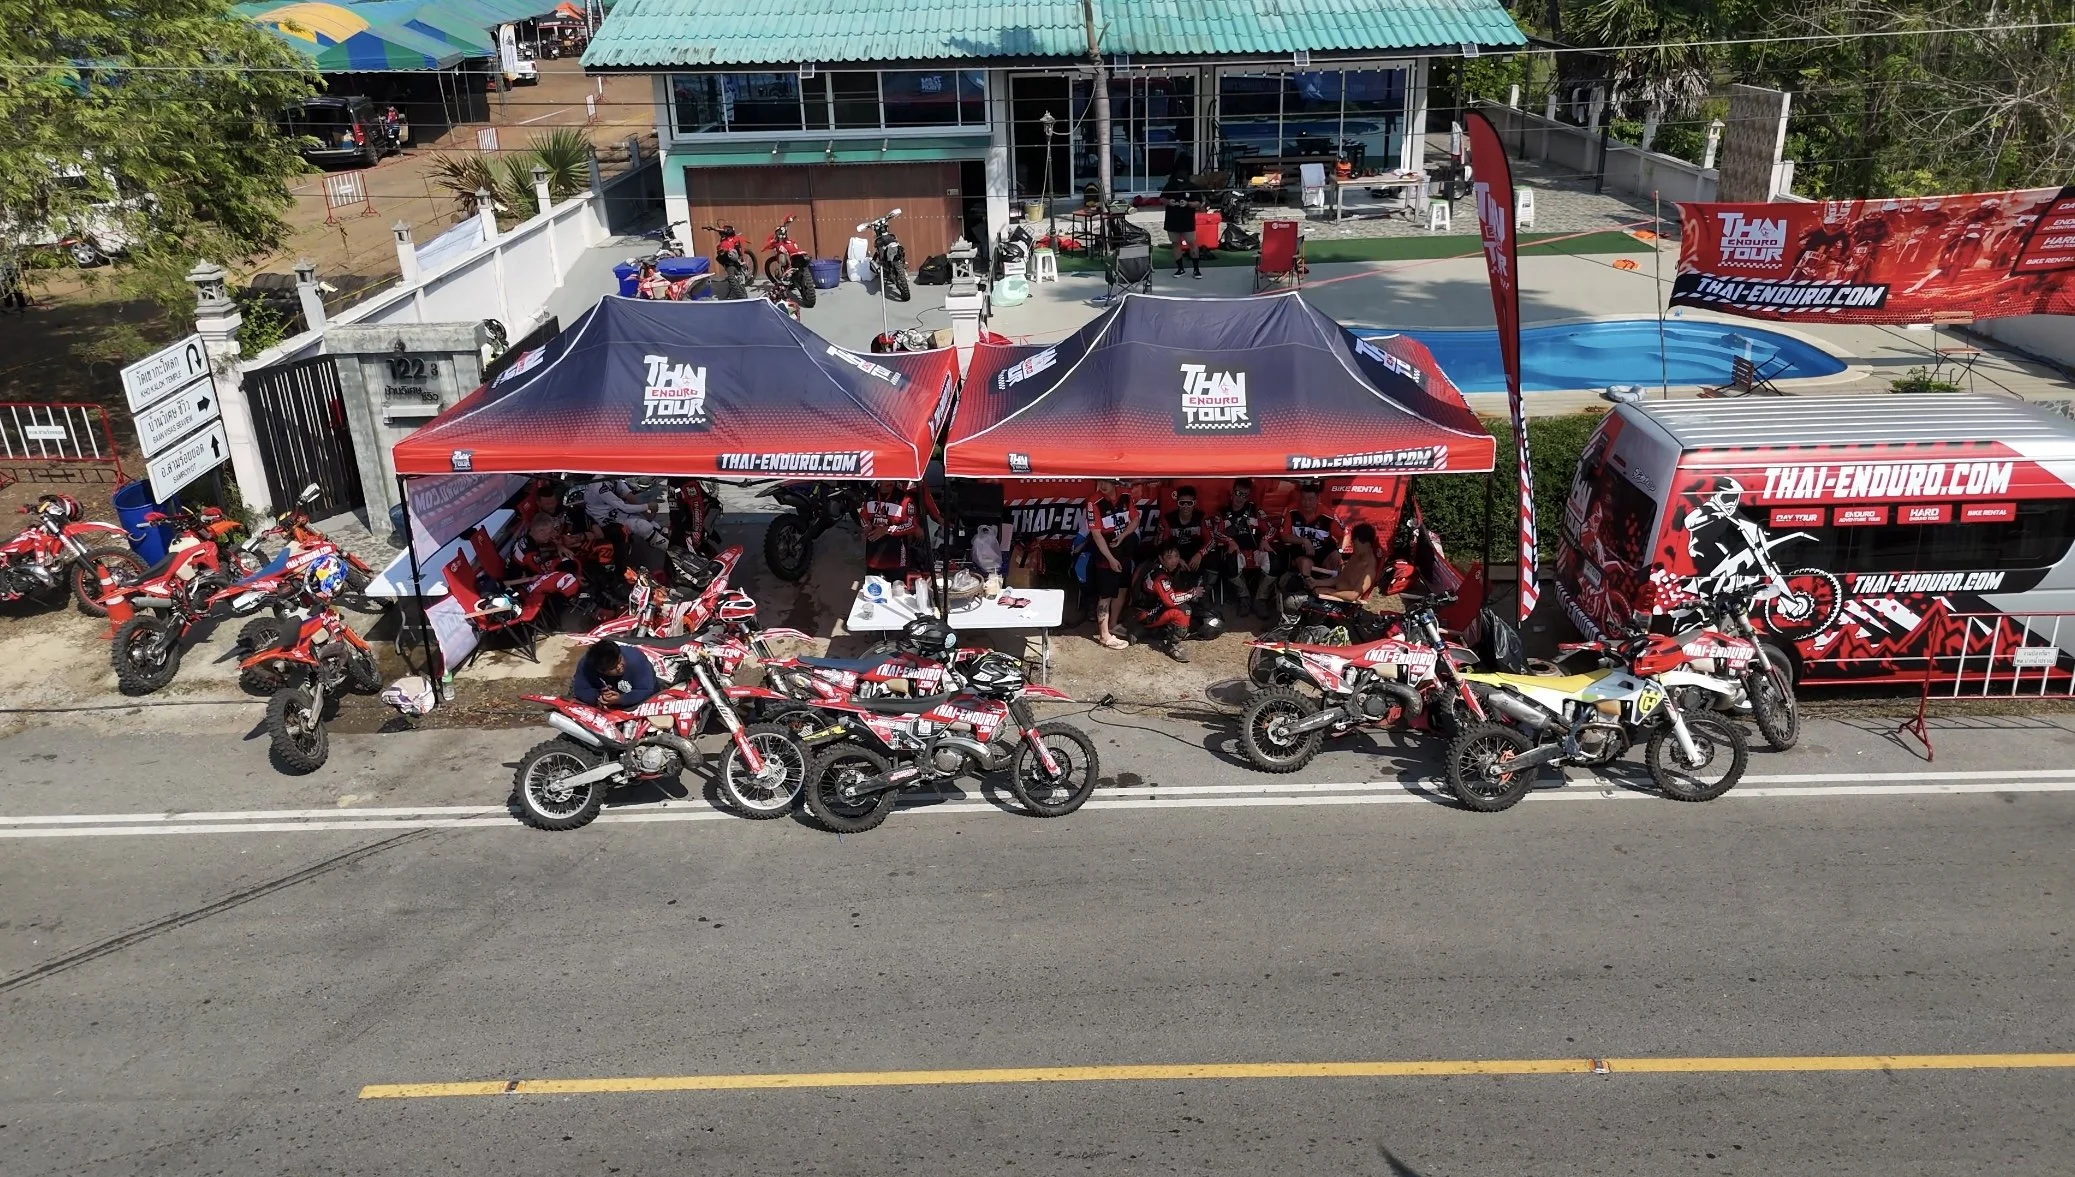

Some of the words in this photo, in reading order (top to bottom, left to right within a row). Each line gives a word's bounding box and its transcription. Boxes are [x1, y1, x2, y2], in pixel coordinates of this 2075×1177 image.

[1717, 212, 1787, 241] THAI
[1719, 248, 1784, 263] TOUR
[2044, 256, 2075, 264] RENTAL
[1697, 278, 1886, 306] THAI-ENDURO.COM
[165, 371, 182, 384] TEMPLE
[385, 358, 427, 380] 122
[430, 363, 439, 376] 3
[644, 355, 707, 387] THAI
[1180, 364, 1246, 395] THAI
[651, 388, 698, 398] ENDURO
[1189, 397, 1239, 405] ENDURO
[643, 400, 706, 418] TOUR
[1182, 407, 1250, 424] TOUR
[721, 453, 858, 471] THAI-ENDURO.COM
[1762, 462, 2014, 499] THAI-ENDURO.COM
[1351, 485, 1384, 494] RENTAL
[1776, 514, 1795, 522] DAY
[1795, 513, 1818, 522] TOUR
[1845, 510, 1876, 518] ENDURO
[1910, 507, 1940, 517] HARD
[1852, 571, 2006, 594] THAI-ENDURO.COM
